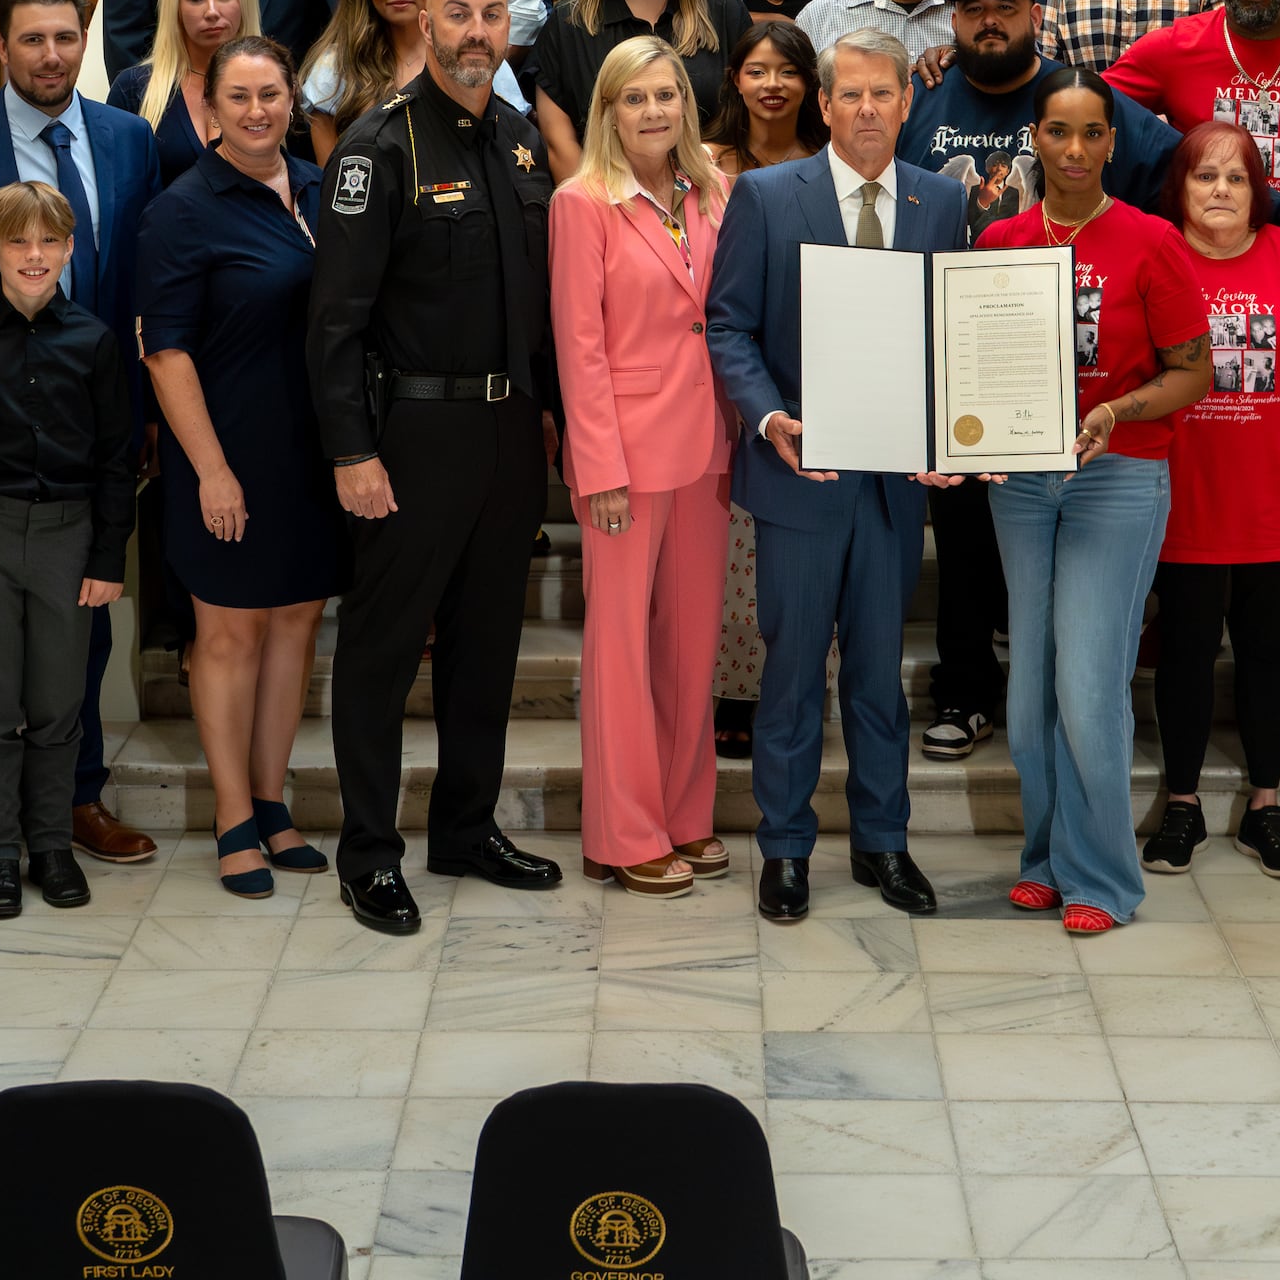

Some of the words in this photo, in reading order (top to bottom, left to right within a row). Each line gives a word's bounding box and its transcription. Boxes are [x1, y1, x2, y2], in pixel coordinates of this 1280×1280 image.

[1231, 72, 1248, 86] In
[930, 124, 1013, 156] Forever
[1214, 287, 1257, 308] Loving
[1210, 303, 1275, 315] MORY
[1234, 412, 1262, 424] forgotten
[83, 1200, 102, 1232] STATE
[102, 1191, 120, 1202] OF
[126, 1191, 168, 1231] GEORGIA
[576, 1204, 597, 1237] STATE
[598, 1196, 615, 1207] OF
[622, 1197, 660, 1238] GEORGIA
[115, 1248, 142, 1259] 1776
[605, 1254, 632, 1265] 1776
[83, 1265, 127, 1278] FIRST
[131, 1265, 175, 1278] LADY
[571, 1271, 665, 1280] GOVERNOR
